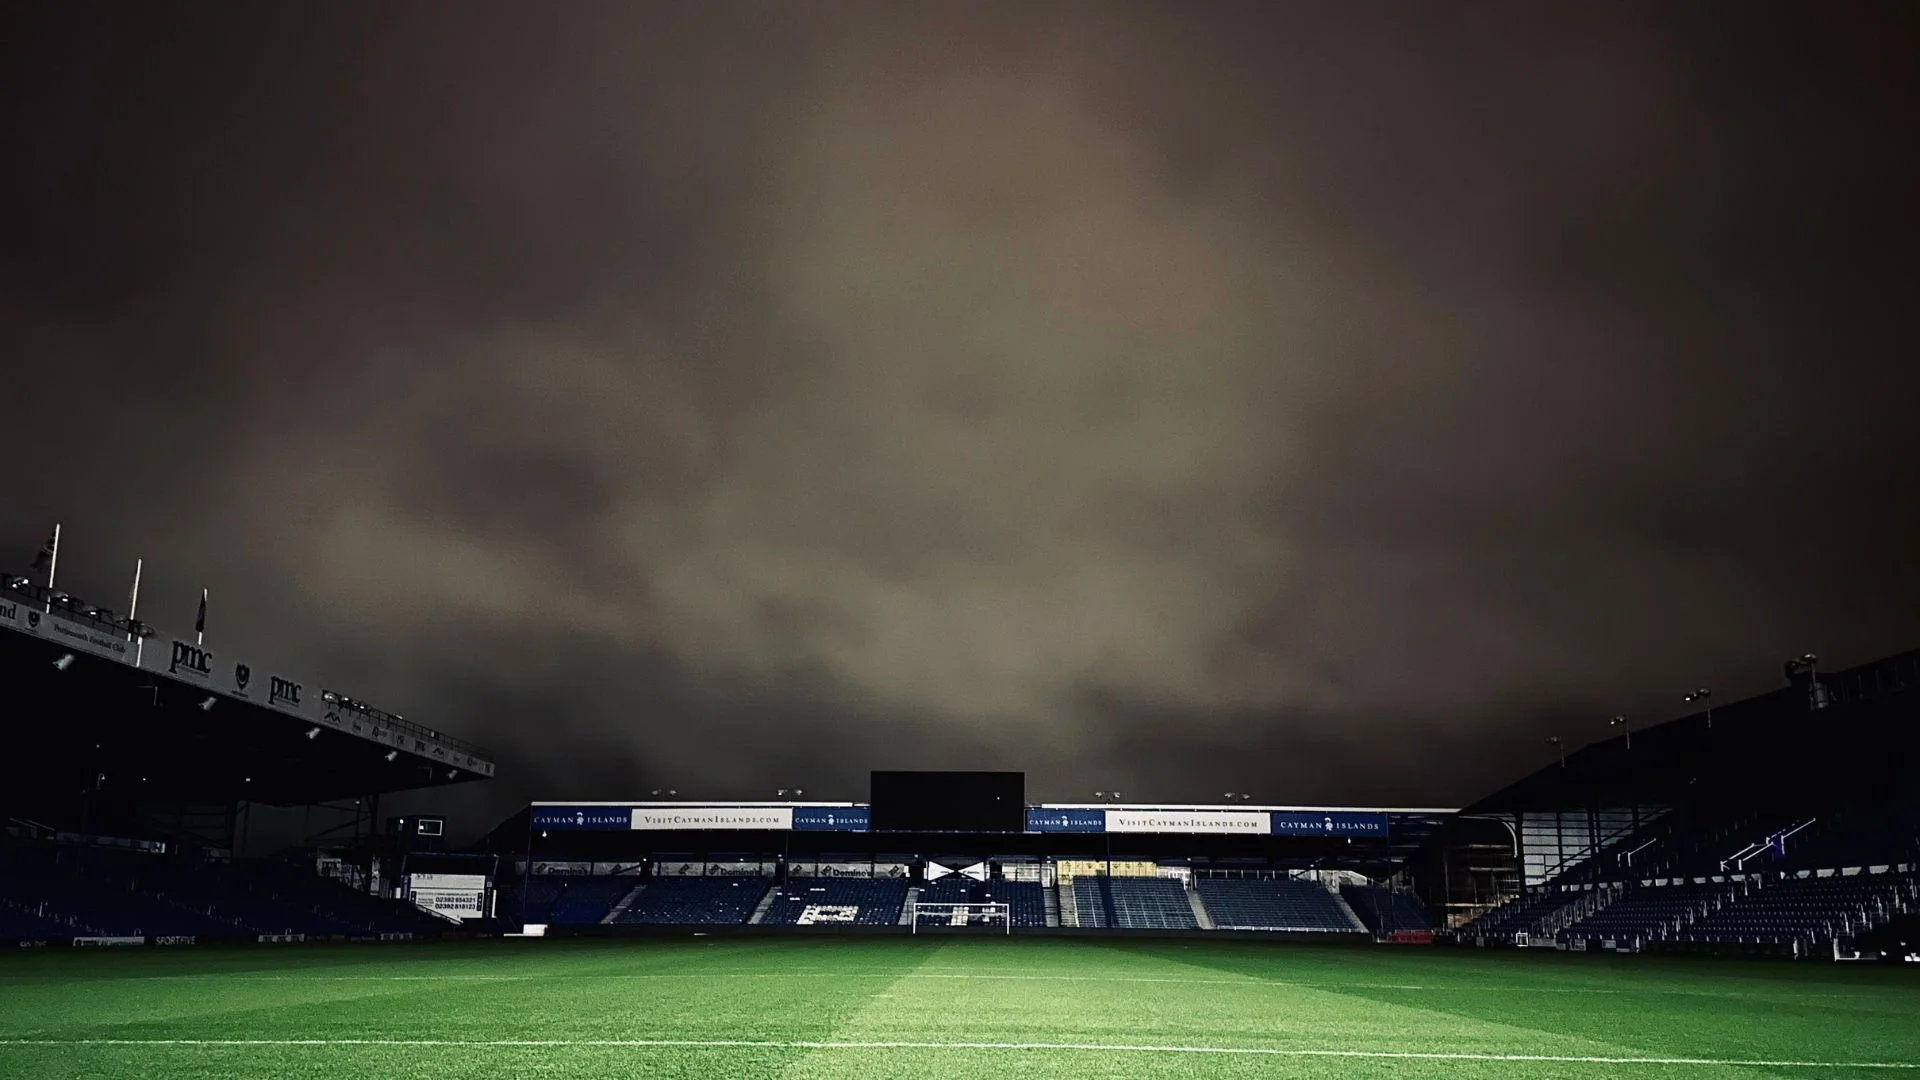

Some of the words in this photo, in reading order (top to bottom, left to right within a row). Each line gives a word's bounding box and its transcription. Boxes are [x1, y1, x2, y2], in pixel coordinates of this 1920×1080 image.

[169, 641, 212, 674] pmc
[268, 676, 302, 704] pmc
[533, 816, 574, 824] CAYMAN
[586, 816, 628, 824] ISLANDS
[1280, 821, 1322, 829] CAYMAN
[1336, 822, 1379, 830] ISLANDS
